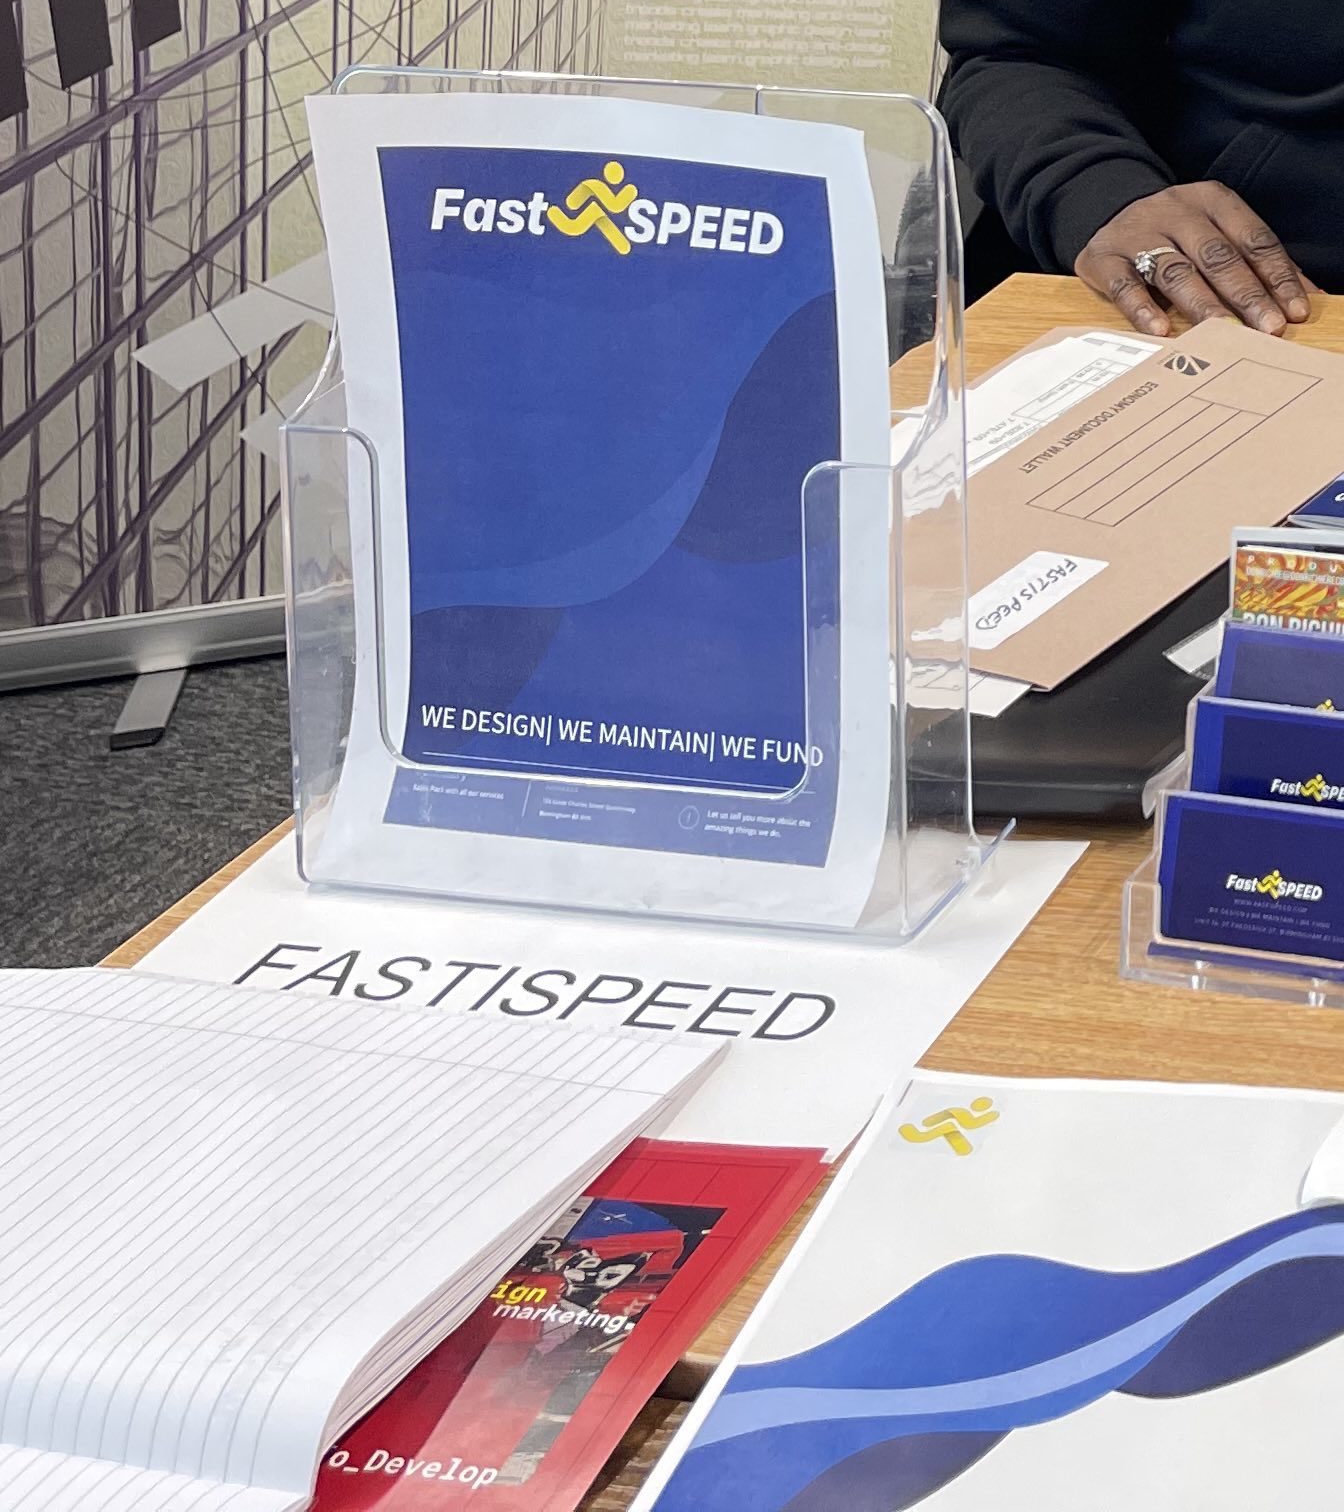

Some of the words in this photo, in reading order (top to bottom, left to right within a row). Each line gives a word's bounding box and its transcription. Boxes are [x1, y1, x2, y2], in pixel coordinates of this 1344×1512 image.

[430, 187, 549, 235] Fast
[623, 199, 785, 255] SPEED
[1114, 381, 1159, 415] ECONOMY
[1061, 411, 1115, 448] DOCUMENT
[1018, 443, 1062, 475] WALLET
[422, 704, 456, 730] WE
[559, 718, 594, 744] WE
[722, 734, 757, 760] WE
[762, 739, 824, 768] FUND
[1271, 778, 1302, 796] Fast
[1226, 873, 1259, 894] Fast
[1278, 881, 1323, 901] SPEED
[328, 1448, 499, 1490] o_Develop
